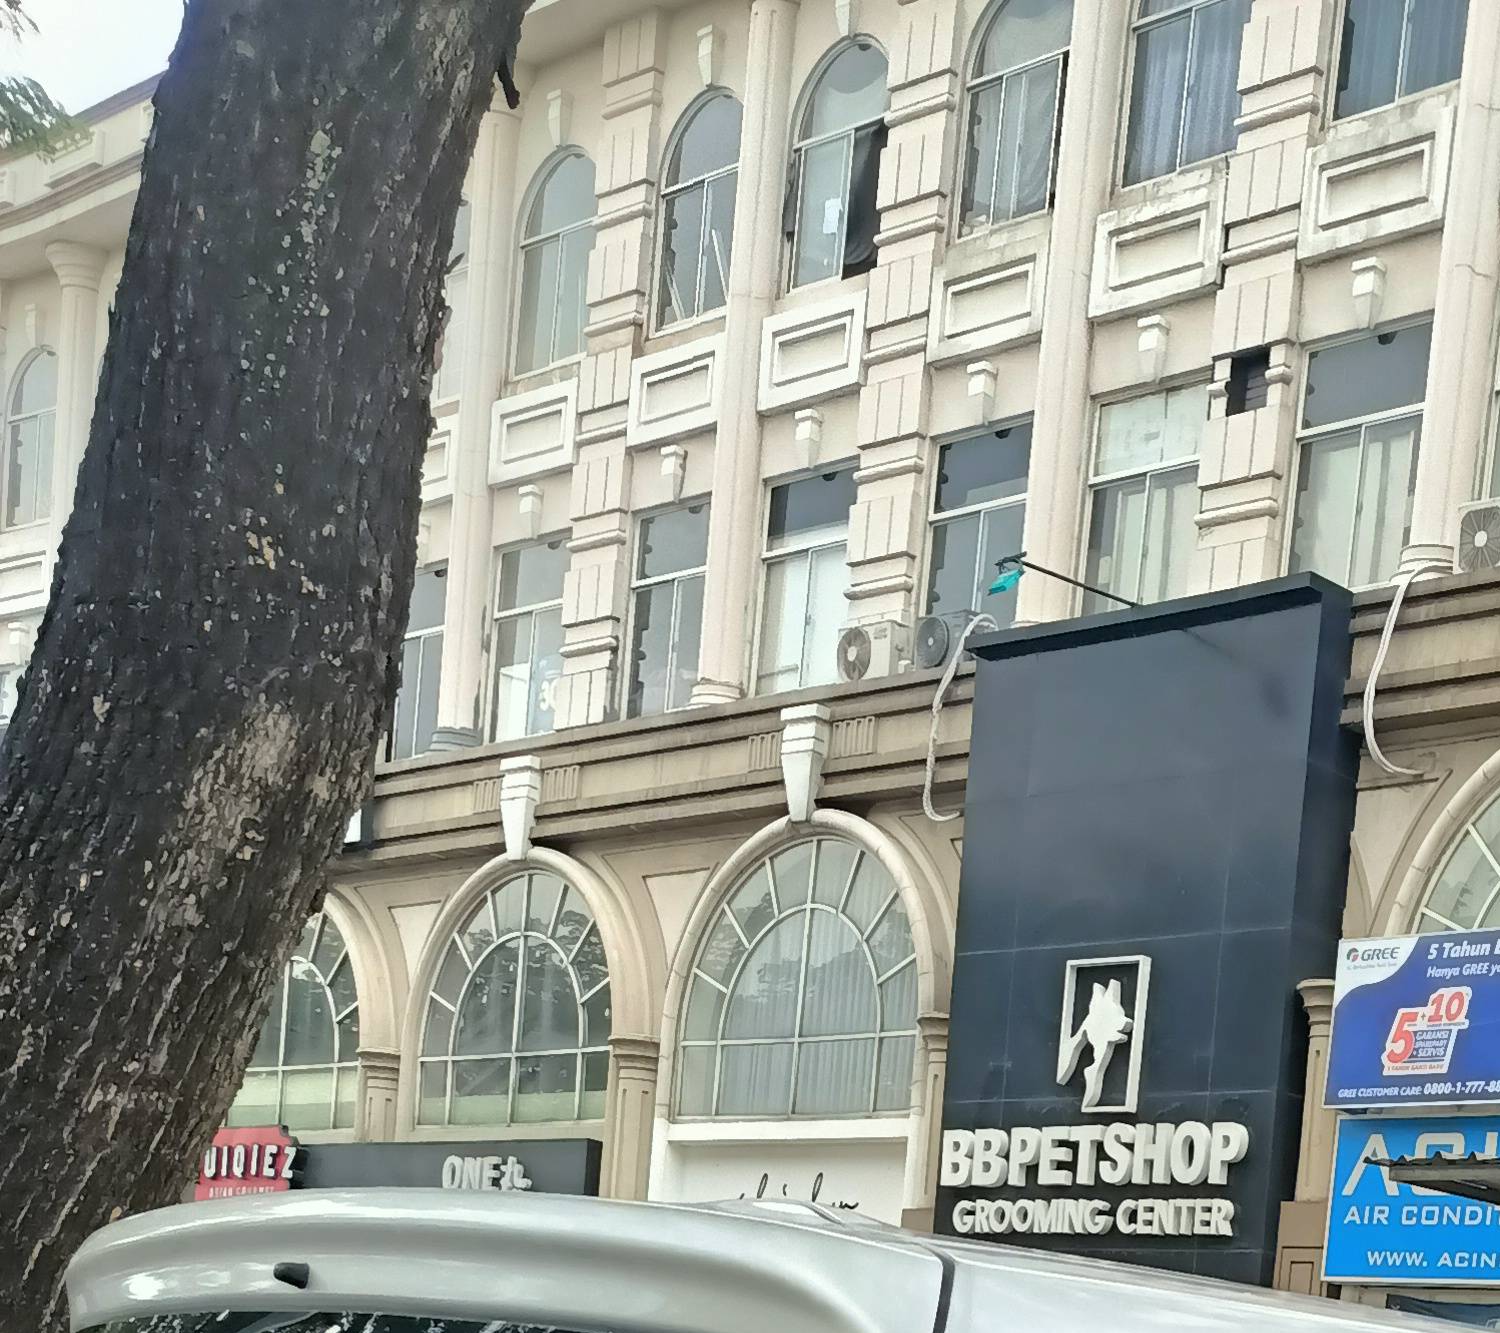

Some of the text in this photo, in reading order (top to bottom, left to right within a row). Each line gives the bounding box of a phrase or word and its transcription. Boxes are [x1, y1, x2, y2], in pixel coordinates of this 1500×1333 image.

[1361, 947, 1400, 962] GREE
[1427, 943, 1440, 960] 5
[1443, 940, 1492, 958] Tahun
[1427, 965, 1461, 980] Hanya
[1462, 962, 1490, 976] GREE
[1427, 991, 1465, 1023] 10
[1387, 1011, 1420, 1064] 5
[1358, 1086, 1399, 1098] CUSTOMER
[940, 1121, 1249, 1188] BBPETSHOP
[442, 1154, 502, 1191] ONE
[952, 1198, 1235, 1237] GROOMING CENTER
[1343, 1206, 1391, 1225] AIR
[1367, 1251, 1428, 1268] WWW.
